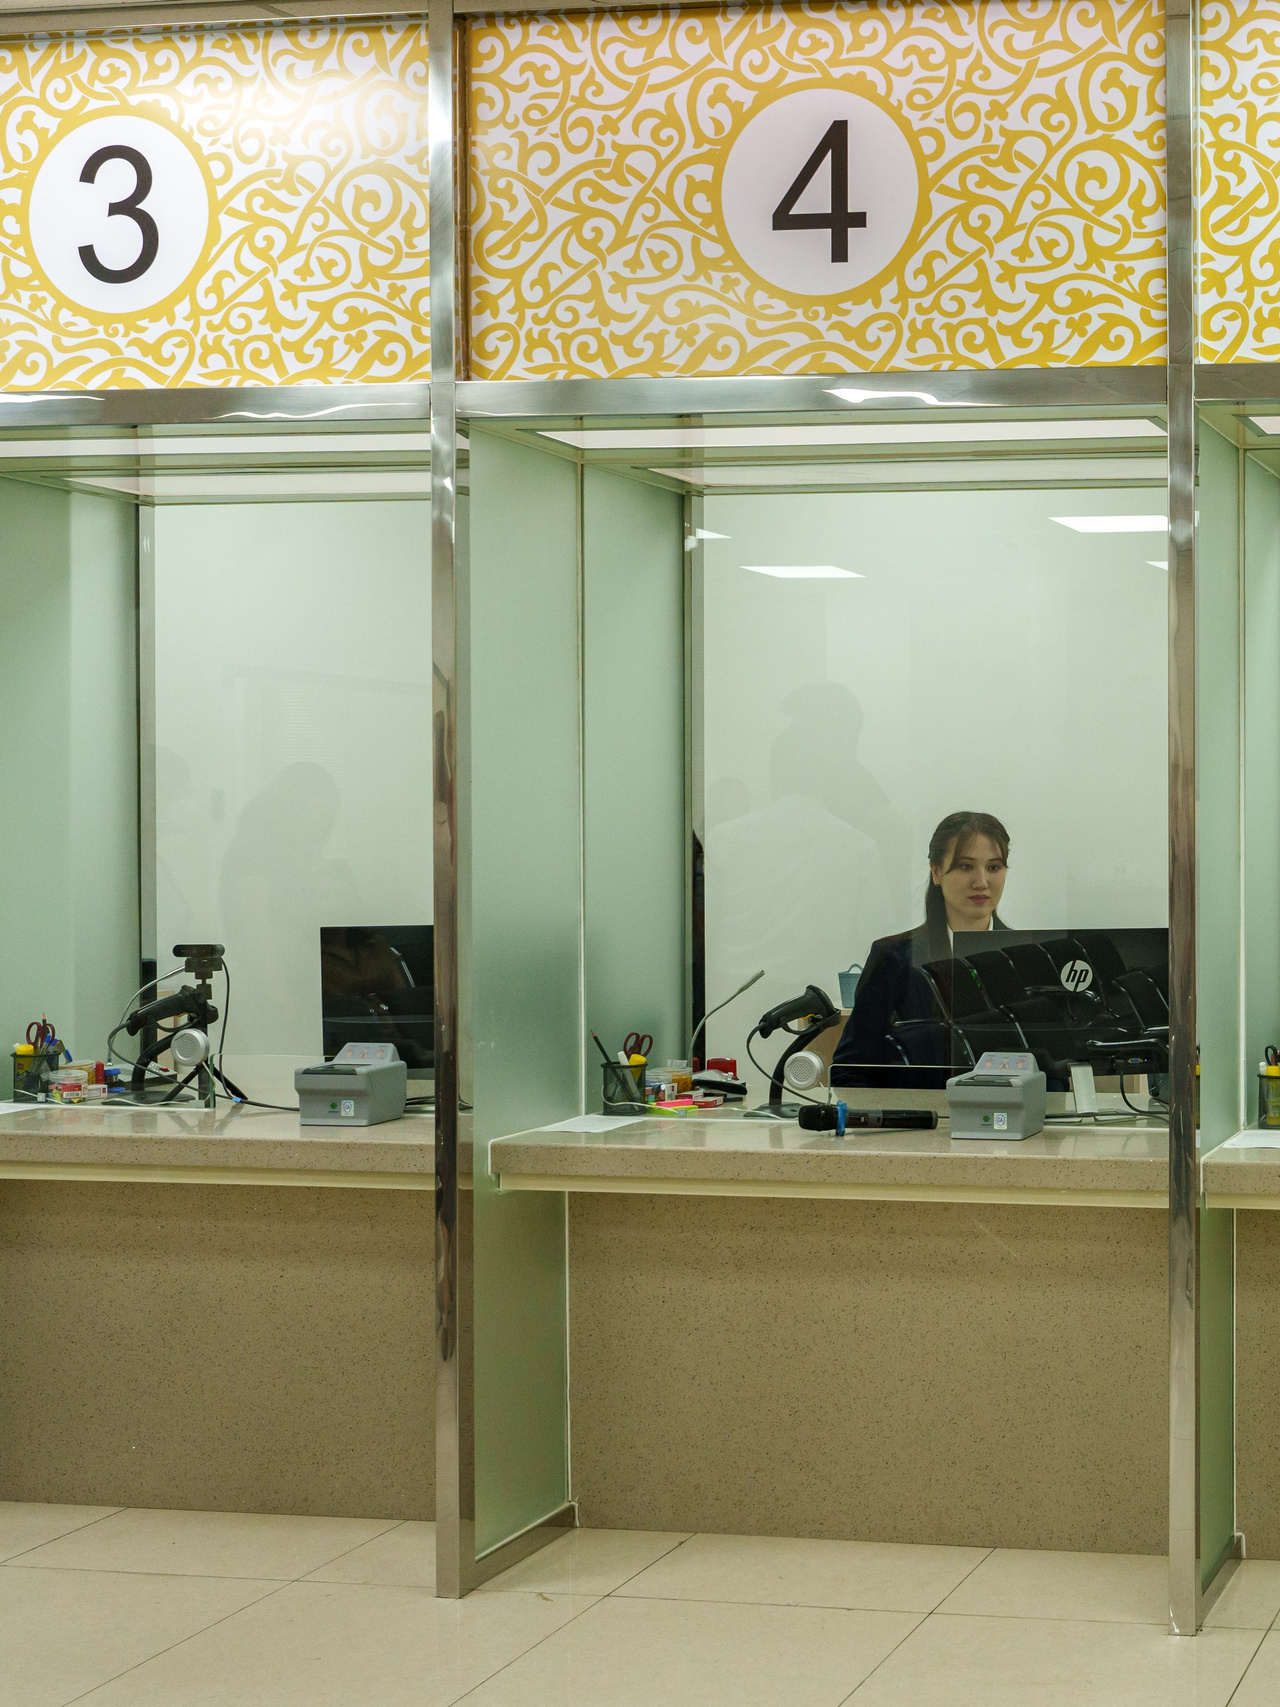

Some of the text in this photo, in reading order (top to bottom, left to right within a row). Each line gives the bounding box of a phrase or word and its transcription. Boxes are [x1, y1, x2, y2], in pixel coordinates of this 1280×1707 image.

[78, 145, 159, 284] 3
[772, 120, 867, 263] 4
[1064, 960, 1091, 992] hp
